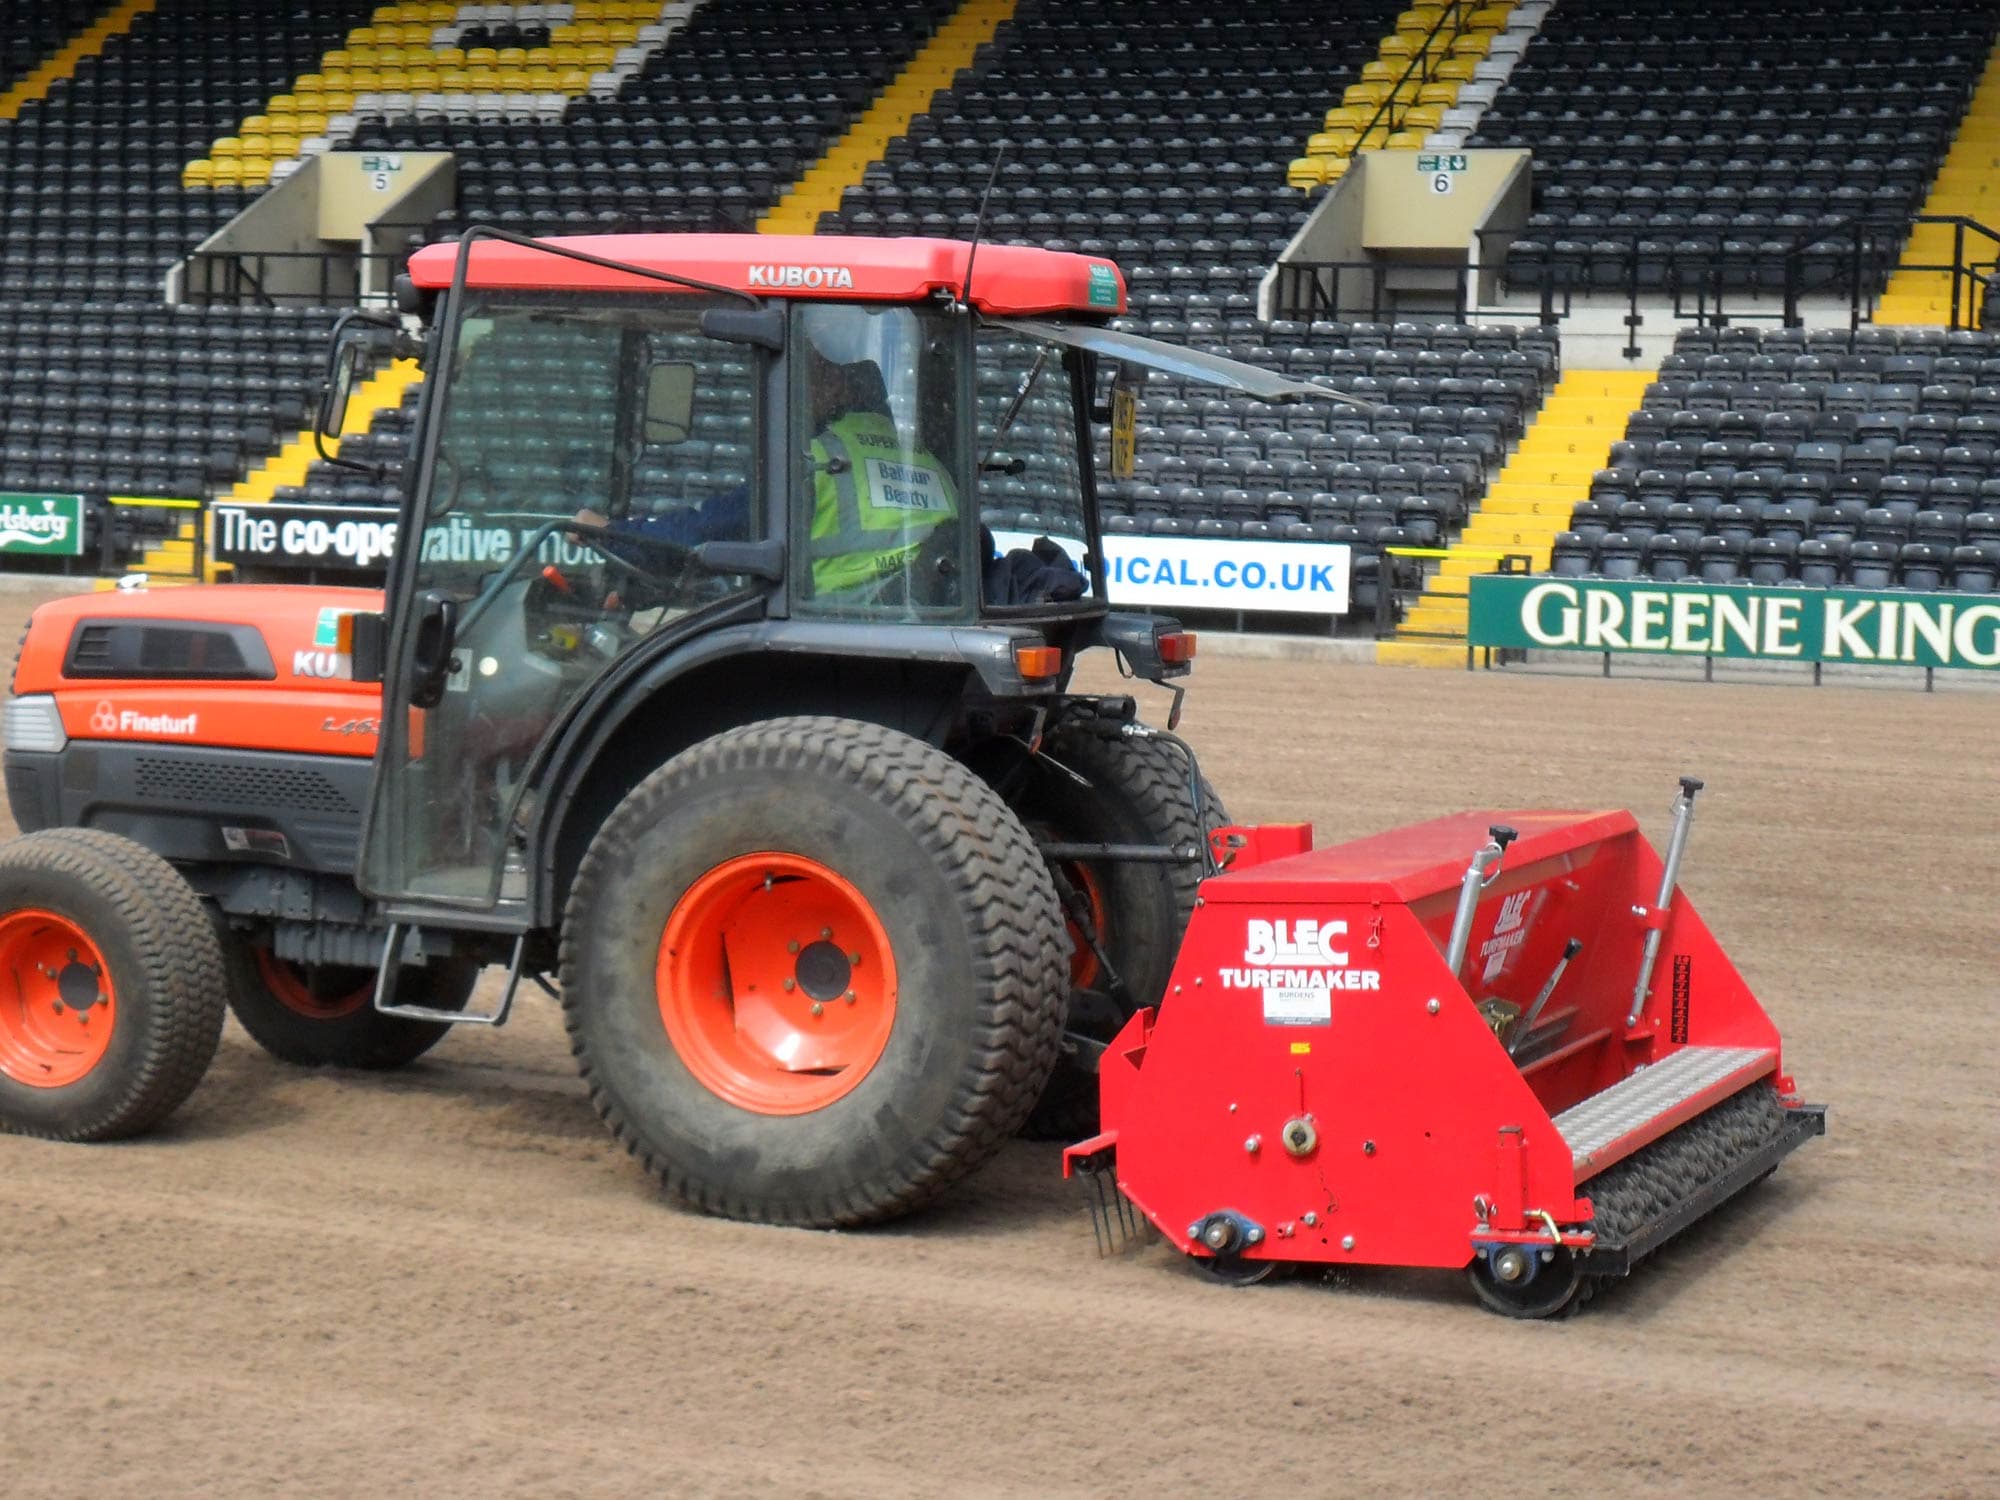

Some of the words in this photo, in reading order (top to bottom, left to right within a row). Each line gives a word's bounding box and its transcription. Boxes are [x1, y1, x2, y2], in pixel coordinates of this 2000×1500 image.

[375, 173, 386, 190] 5
[1434, 173, 1449, 193] 6
[748, 264, 854, 289] KUBOTA
[878, 462, 930, 486] Balfour
[882, 485, 929, 508] Beatty
[218, 508, 277, 553] The
[1520, 582, 1803, 655] GREENE
[1822, 597, 2000, 666] KING
[120, 710, 198, 735] Fineturf
[1244, 919, 1349, 966] BLEC
[1218, 968, 1381, 991] TURFMAKER
